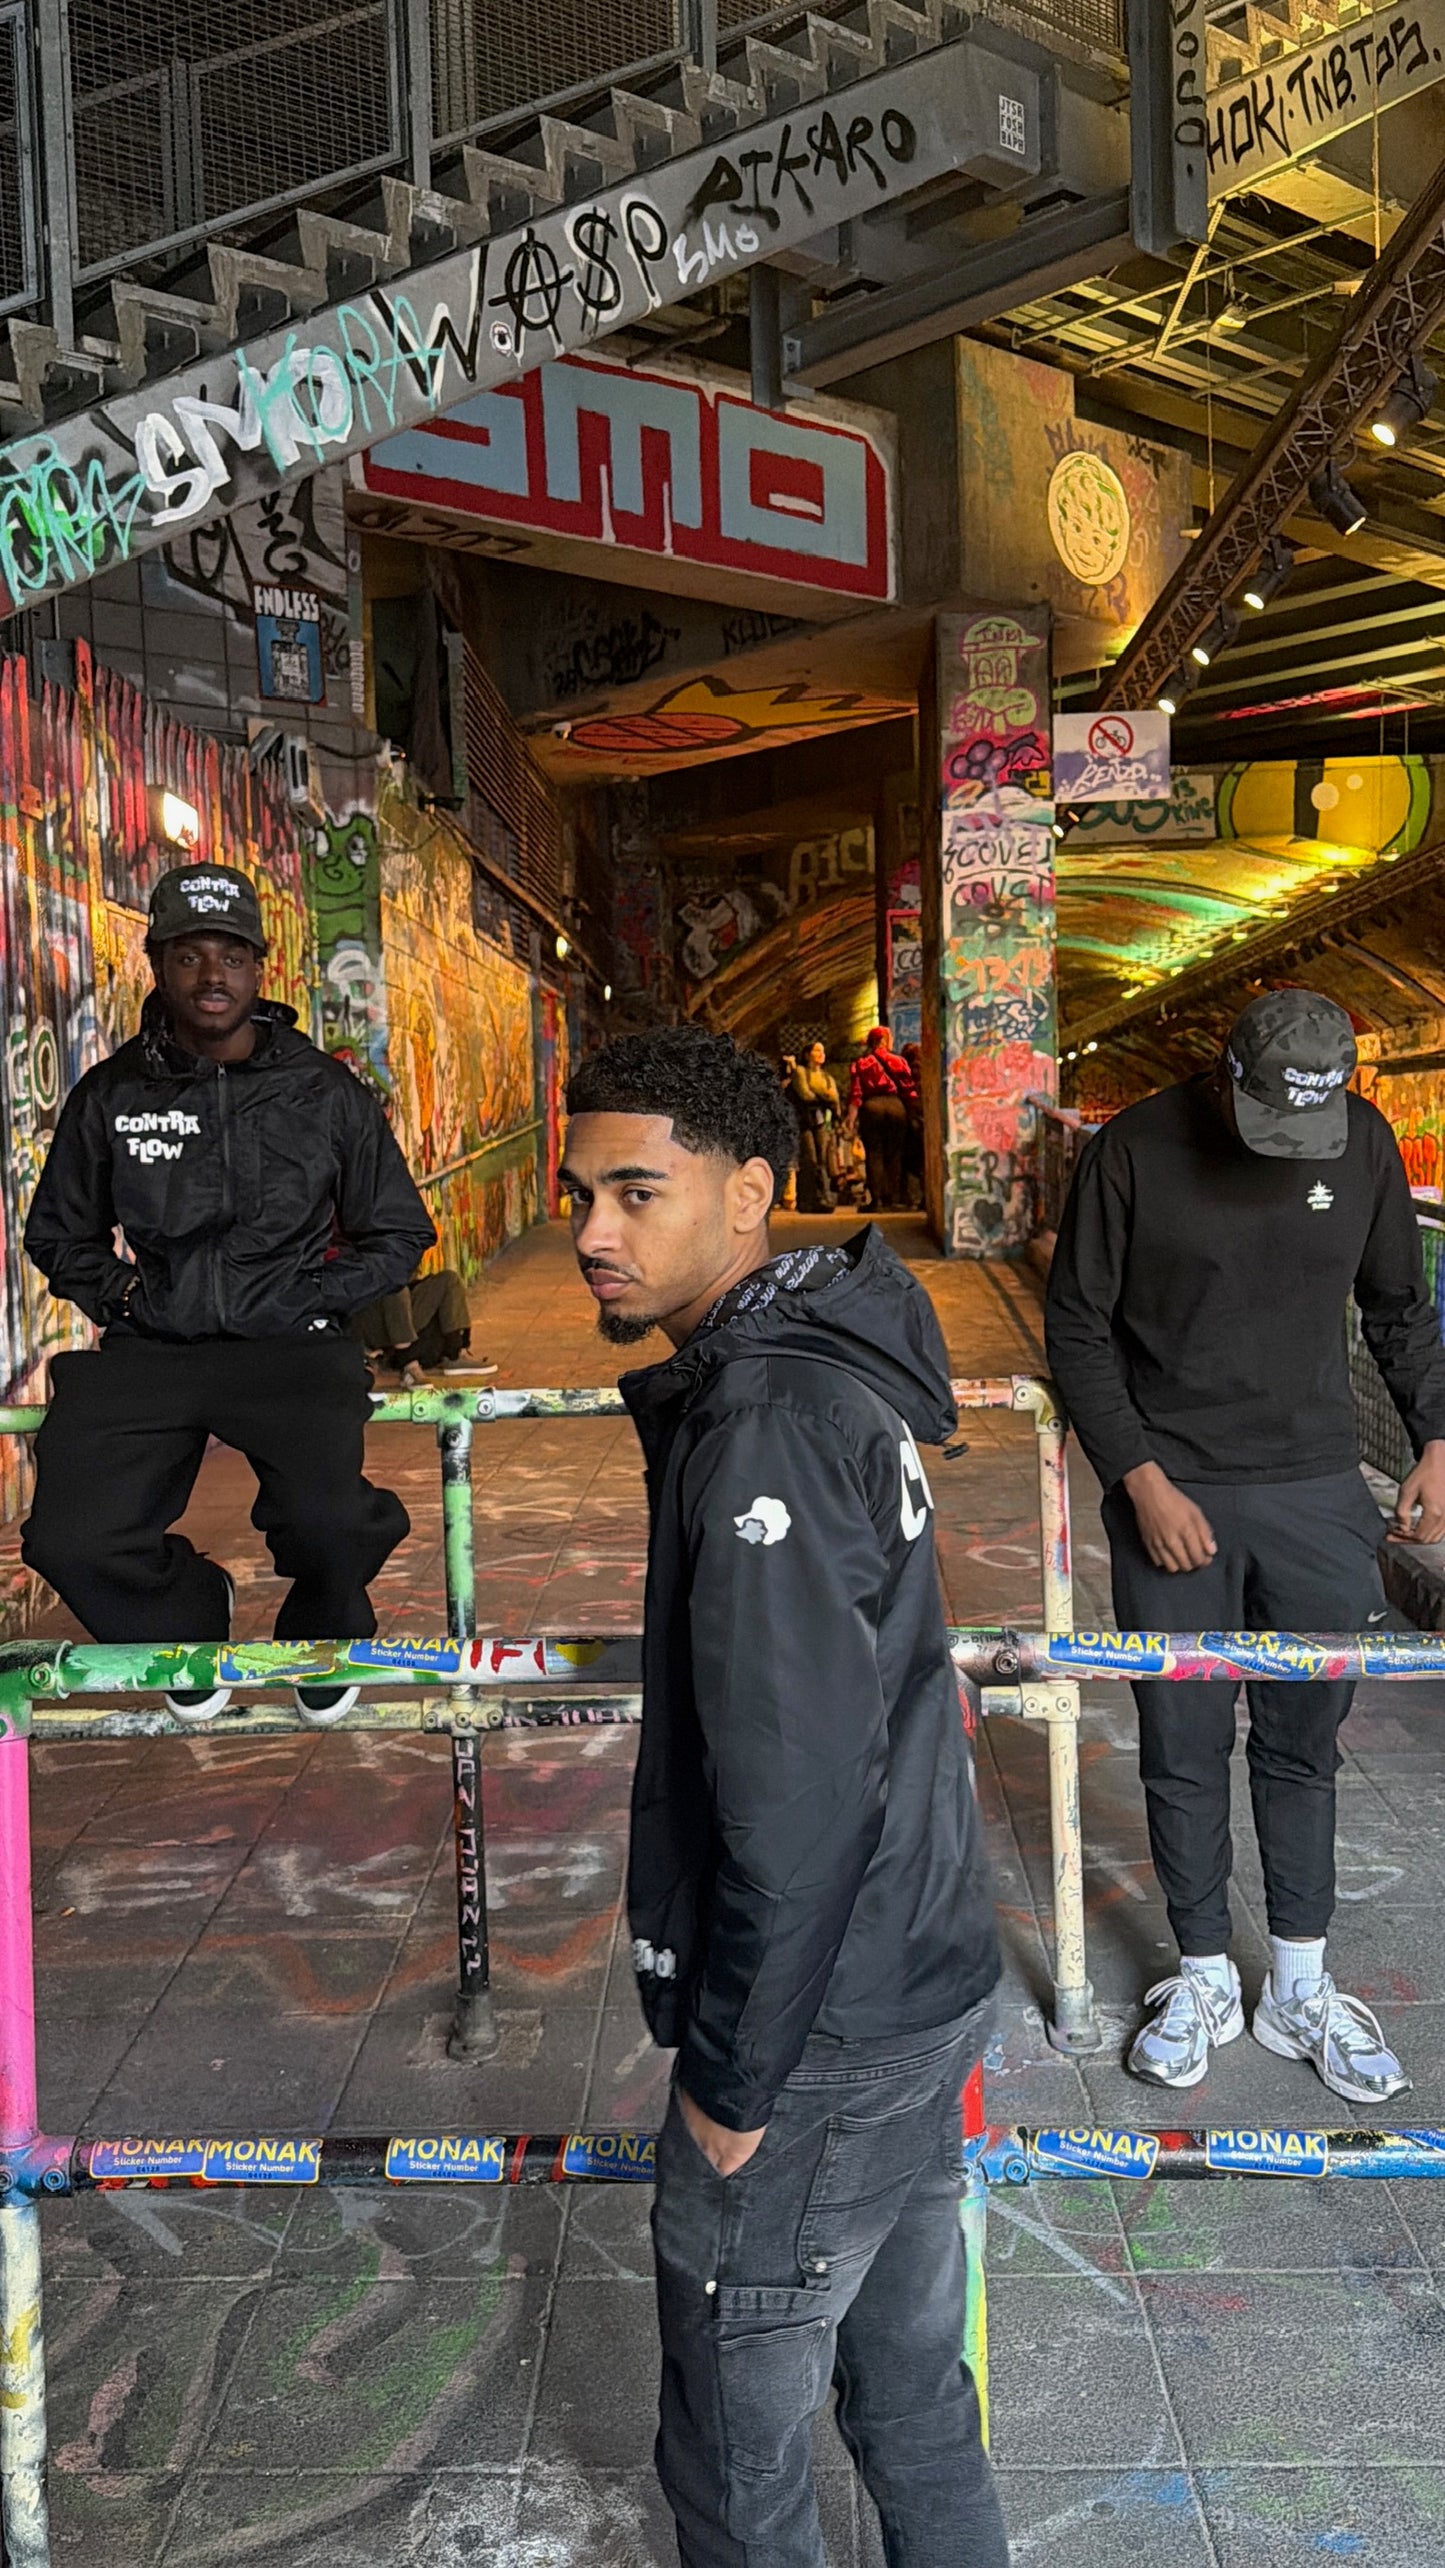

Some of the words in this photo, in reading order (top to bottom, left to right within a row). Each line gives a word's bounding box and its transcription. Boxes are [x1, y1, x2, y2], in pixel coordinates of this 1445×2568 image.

[253, 584, 320, 622] ENDLESS
[179, 875, 240, 898] CONTRA
[188, 894, 231, 913] FLOW
[1283, 1066, 1345, 1088] CONTRA
[1287, 1085, 1330, 1107] FLOW
[115, 1111, 201, 1136] CONTRA
[126, 1137, 184, 1164] FLOW
[371, 1647, 400, 1659] Sticker
[404, 1652, 439, 1662] Number
[1071, 1645, 1103, 1657] Sticker
[1105, 1650, 1142, 1662] Number
[114, 2158, 145, 2167] Sticker
[147, 2156, 183, 2165] Number
[586, 2156, 618, 2169] Sticker
[1059, 2140, 1092, 2156] Sticker
[1094, 2153, 1129, 2169] Number
[1266, 2155, 1302, 2166] Number
[226, 2161, 257, 2172] Sticker
[259, 2163, 295, 2173] Number
[410, 2160, 441, 2170] Sticker
[443, 2163, 479, 2172] Number
